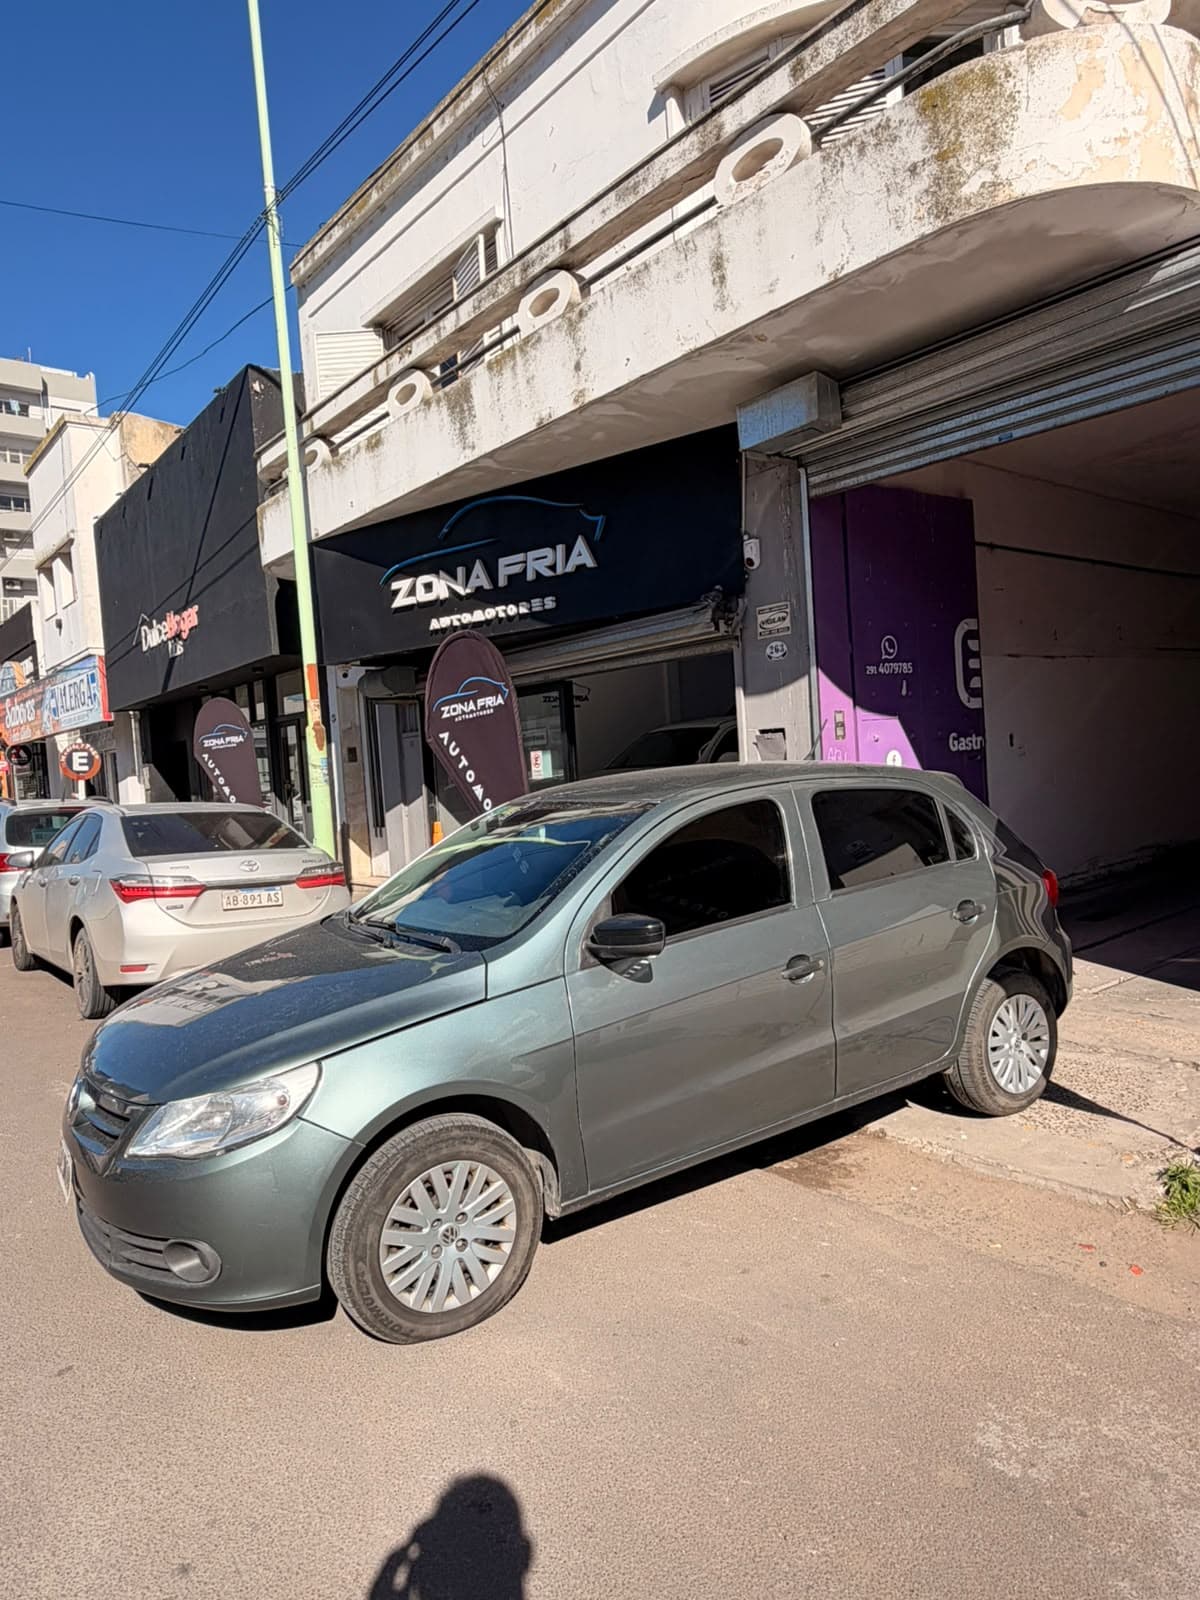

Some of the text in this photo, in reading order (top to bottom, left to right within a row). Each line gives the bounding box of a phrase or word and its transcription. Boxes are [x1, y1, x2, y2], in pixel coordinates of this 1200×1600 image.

[391, 534, 598, 609] ZONA FRIA
[429, 596, 556, 631] AUTOMOTORES
[878, 662, 913, 674] 4079785
[441, 694, 504, 719] ZONA FRIA
[203, 737, 226, 748] ZONA
[72, 751, 89, 772] E
[225, 892, 281, 907] AB 891 AS
